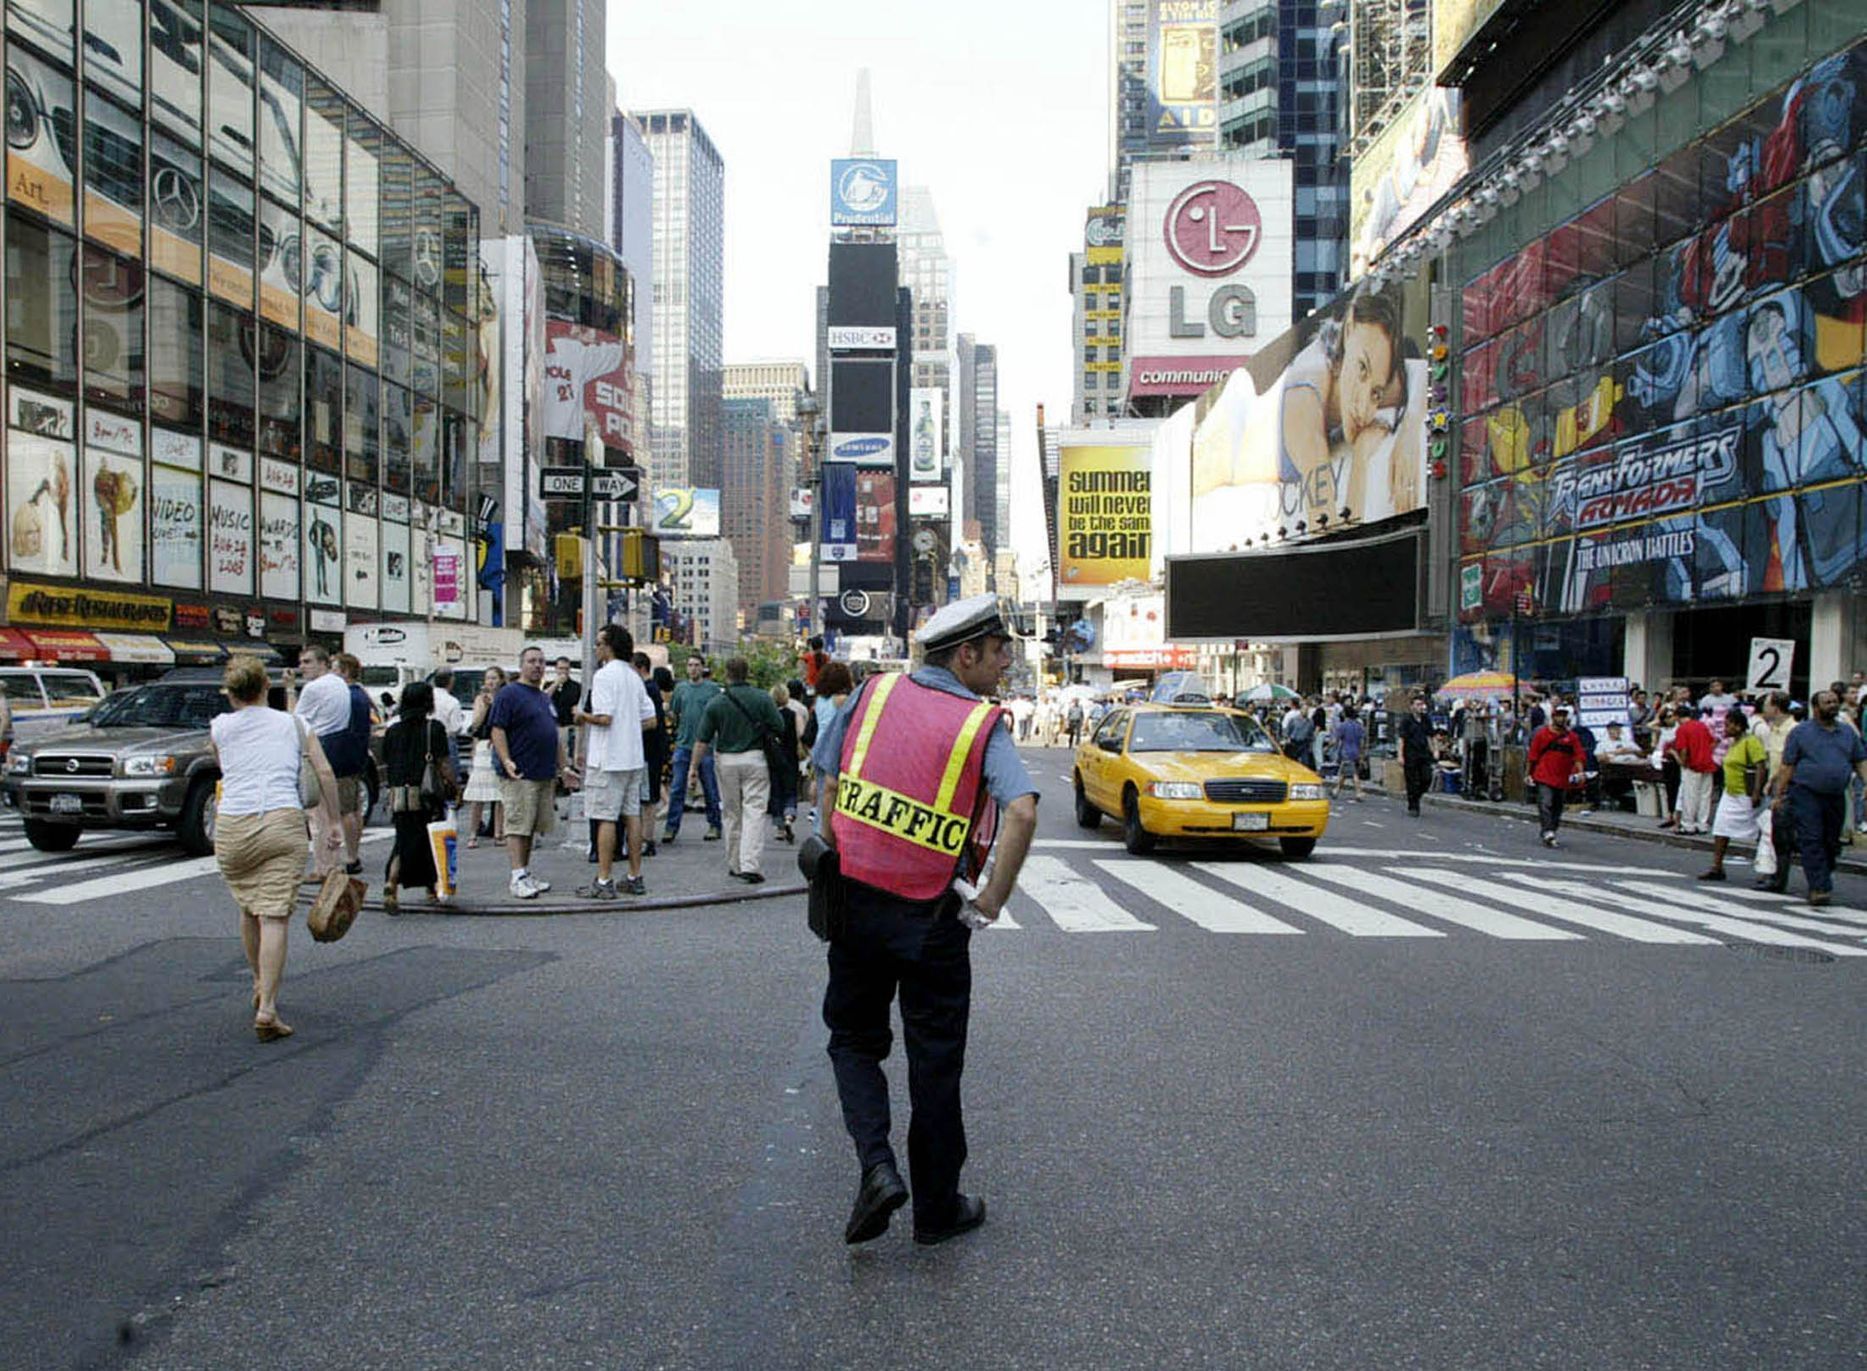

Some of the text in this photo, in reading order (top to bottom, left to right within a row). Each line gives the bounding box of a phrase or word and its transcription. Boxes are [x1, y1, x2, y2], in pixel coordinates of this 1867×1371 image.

[1169, 283, 1257, 339] LG
[832, 332, 871, 344] HSBC
[552, 476, 625, 492] ONE WAY
[1553, 433, 1742, 514] TRANSFORMERS
[210, 504, 250, 530] MUSIC
[1069, 494, 1099, 515] will
[1579, 475, 1695, 524] ARMADA
[1069, 516, 1150, 530] be the sam
[1575, 547, 1595, 571] THE
[1648, 529, 1694, 560] BATTLES
[1755, 646, 1782, 688] 2
[838, 777, 966, 851] TRAFFIC
